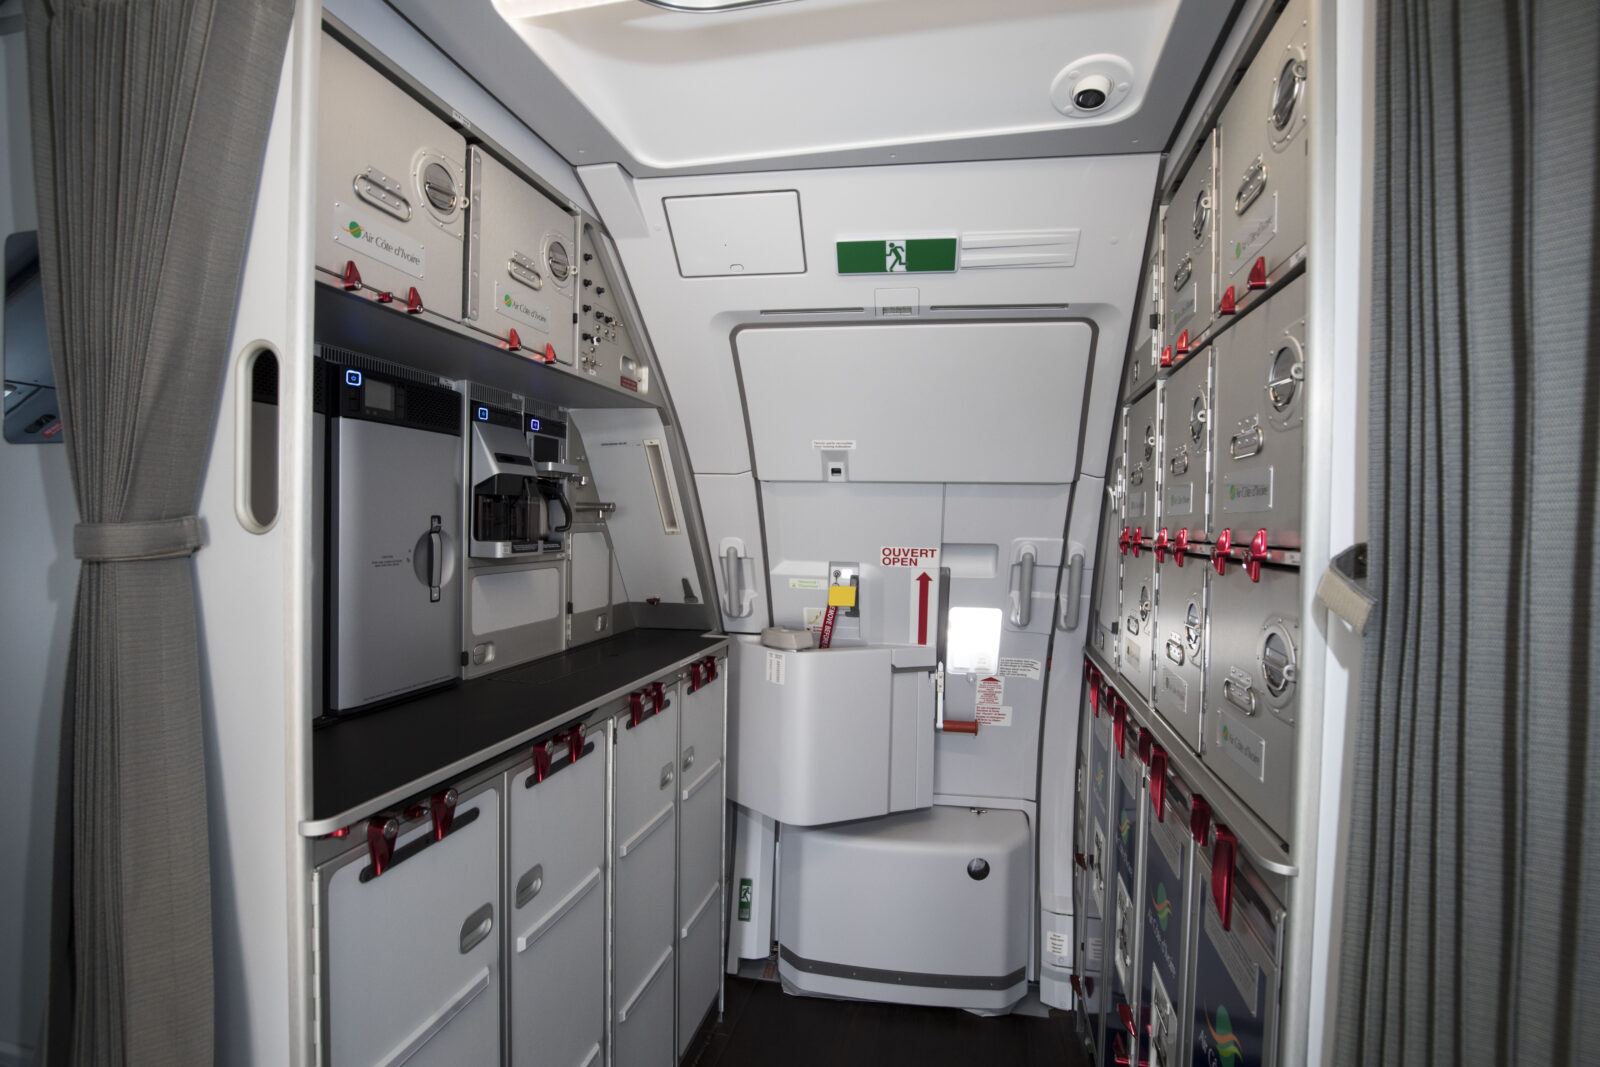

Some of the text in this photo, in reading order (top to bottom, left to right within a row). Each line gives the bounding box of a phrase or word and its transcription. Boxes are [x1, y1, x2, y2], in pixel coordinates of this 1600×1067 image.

[362, 231, 421, 265] Air Côte d'Ivoire
[882, 547, 937, 558] OUVERT
[882, 557, 918, 566] OPEN
